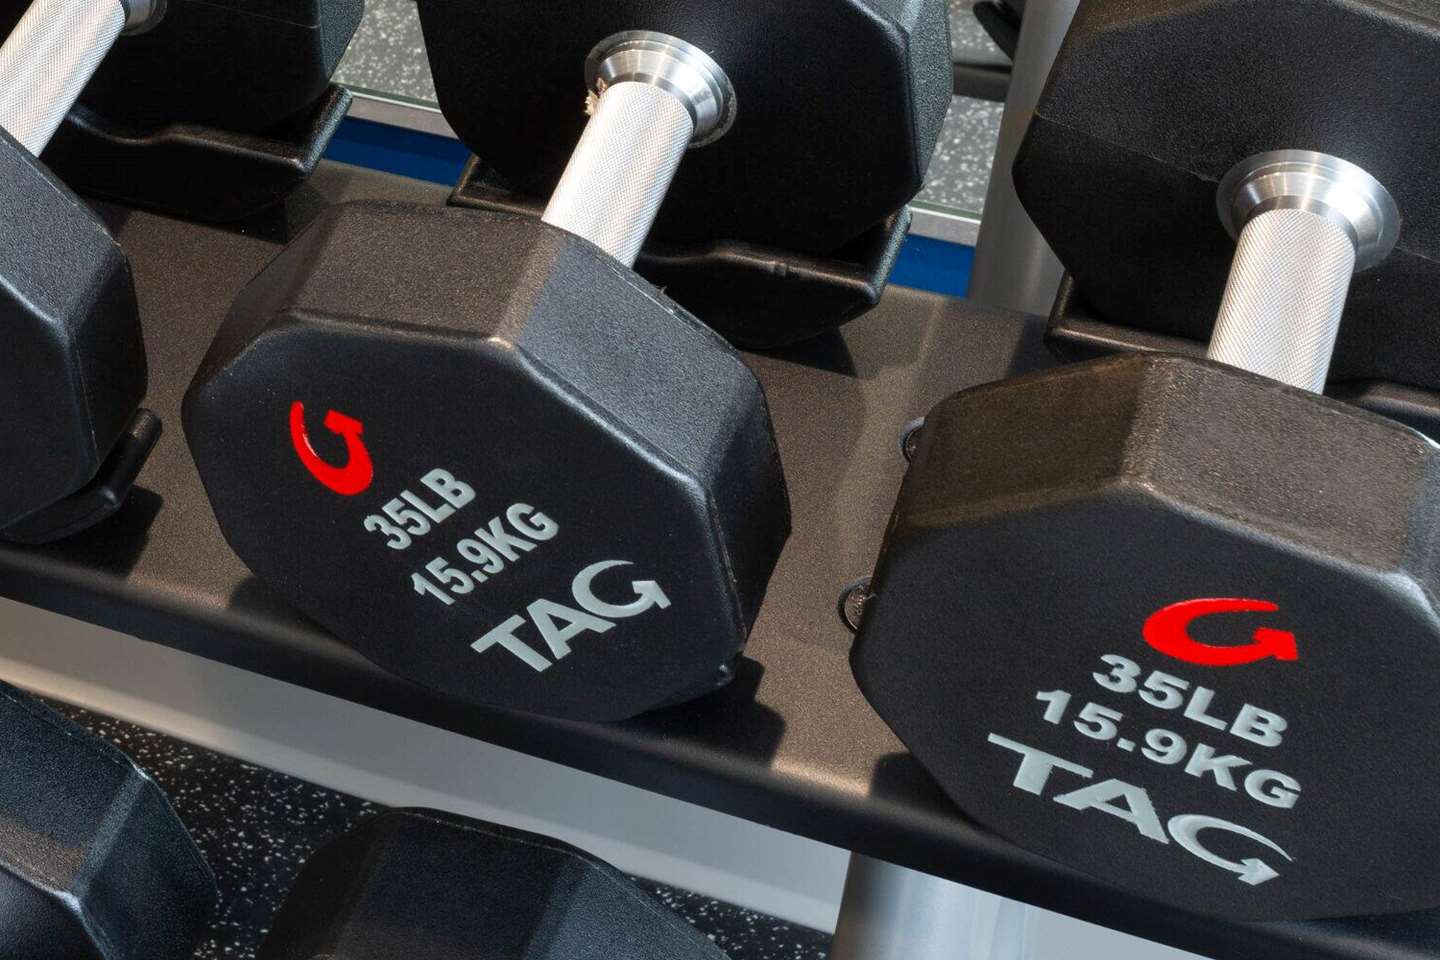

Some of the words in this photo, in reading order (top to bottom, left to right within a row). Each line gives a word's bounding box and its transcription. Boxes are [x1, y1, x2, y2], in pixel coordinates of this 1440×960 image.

[363, 467, 476, 550] 35LB
[410, 502, 559, 606] 15.9KG
[470, 559, 672, 673] TAG
[1036, 690, 1301, 809] 15.9KG
[1092, 654, 1288, 748] 35LB
[987, 732, 1298, 886] TAG
